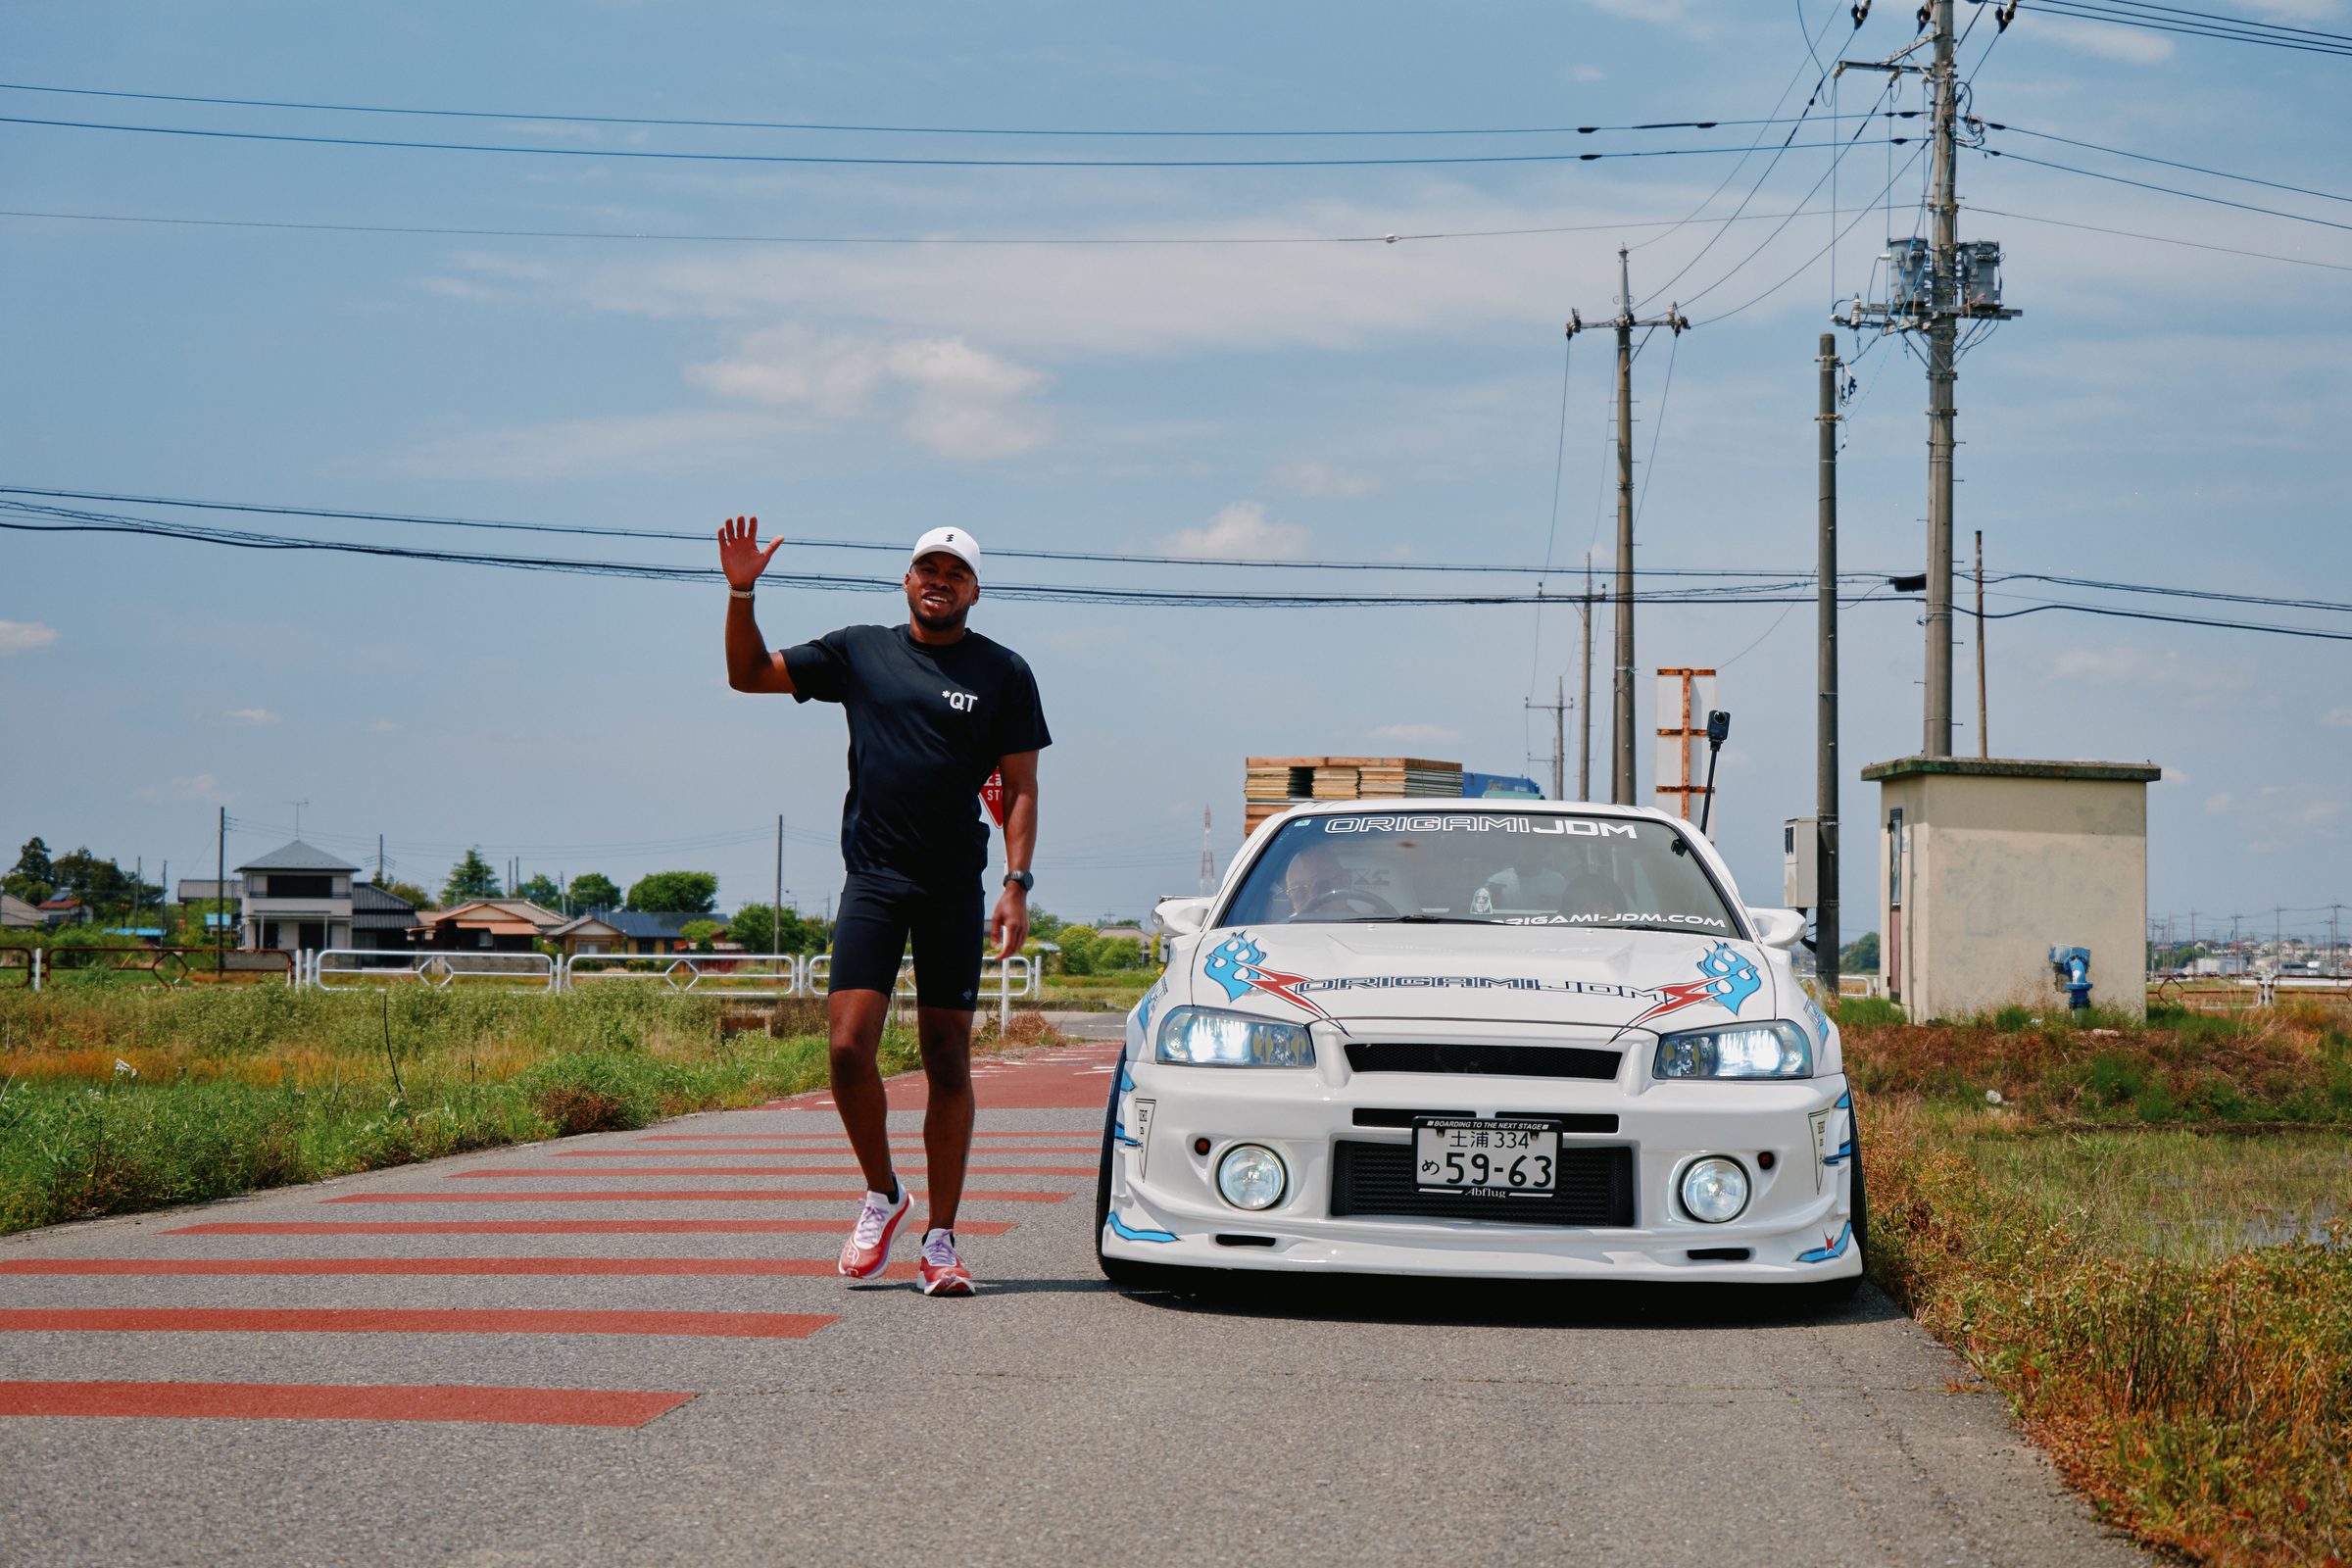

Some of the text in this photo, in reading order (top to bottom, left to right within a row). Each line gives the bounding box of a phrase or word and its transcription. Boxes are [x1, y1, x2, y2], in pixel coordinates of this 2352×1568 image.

[987, 789, 1003, 801] ST
[1449, 1130, 1529, 1150] 土浦 334
[1421, 1152, 1552, 1188] め 59-63
[1465, 1187, 1507, 1199] Abflug
